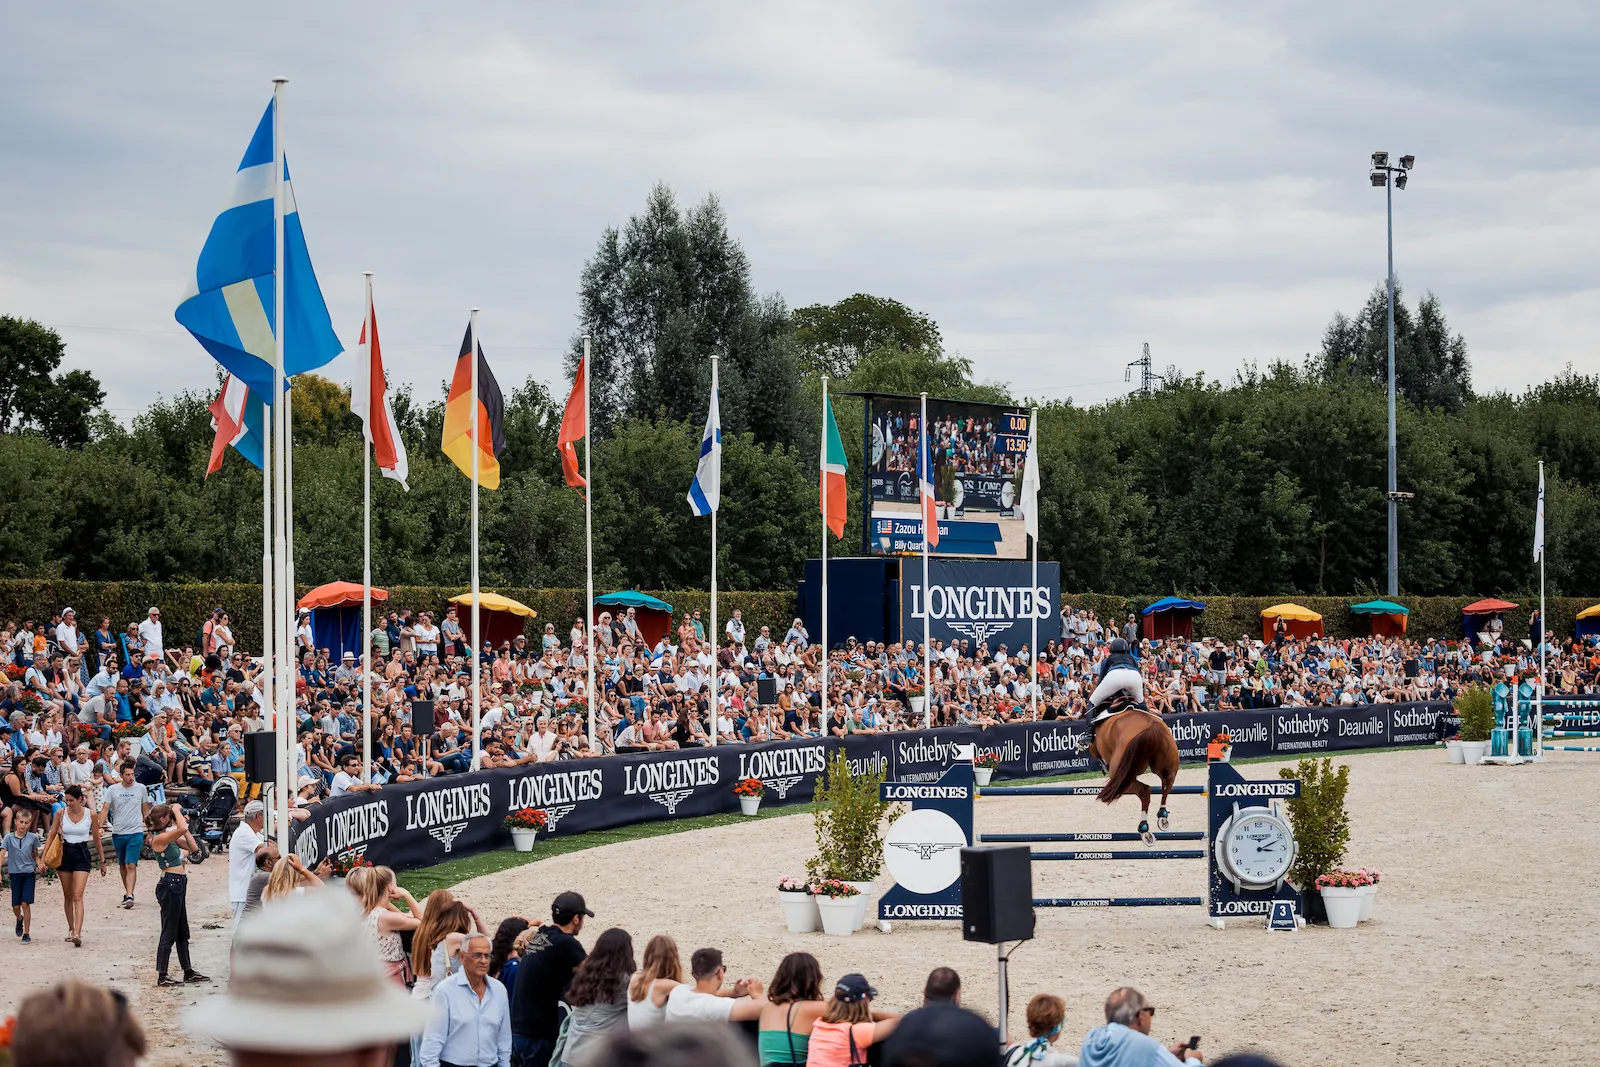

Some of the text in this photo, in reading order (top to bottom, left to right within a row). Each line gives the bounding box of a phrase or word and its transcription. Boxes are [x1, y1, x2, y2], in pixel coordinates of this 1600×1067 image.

[1010, 416, 1027, 431] 0.00
[1005, 438, 1027, 452] 13.50
[895, 522, 917, 535] Zazou
[894, 540, 907, 552] Billy
[910, 585, 1051, 620] LONGINES
[1221, 722, 1268, 743] Deauville
[1278, 713, 1329, 737] Sotheby's
[1338, 716, 1384, 737] Deauville
[1312, 739, 1328, 748] REALTY
[900, 736, 958, 767] Sotheby's
[1194, 747, 1208, 757] REALT
[739, 745, 826, 781] LONGINES
[1032, 757, 1090, 772] INTERNATIONAL REALTY
[624, 756, 720, 796] LONGINES
[508, 769, 603, 812] LONGINES
[885, 786, 968, 799] LONGINES
[1215, 783, 1296, 797] LONGINES
[405, 782, 491, 831] LONGINES
[325, 800, 389, 856] LONGINES
[1280, 844, 1287, 852] 3
[1074, 852, 1113, 860] LONGINES
[1279, 905, 1287, 917] 3
